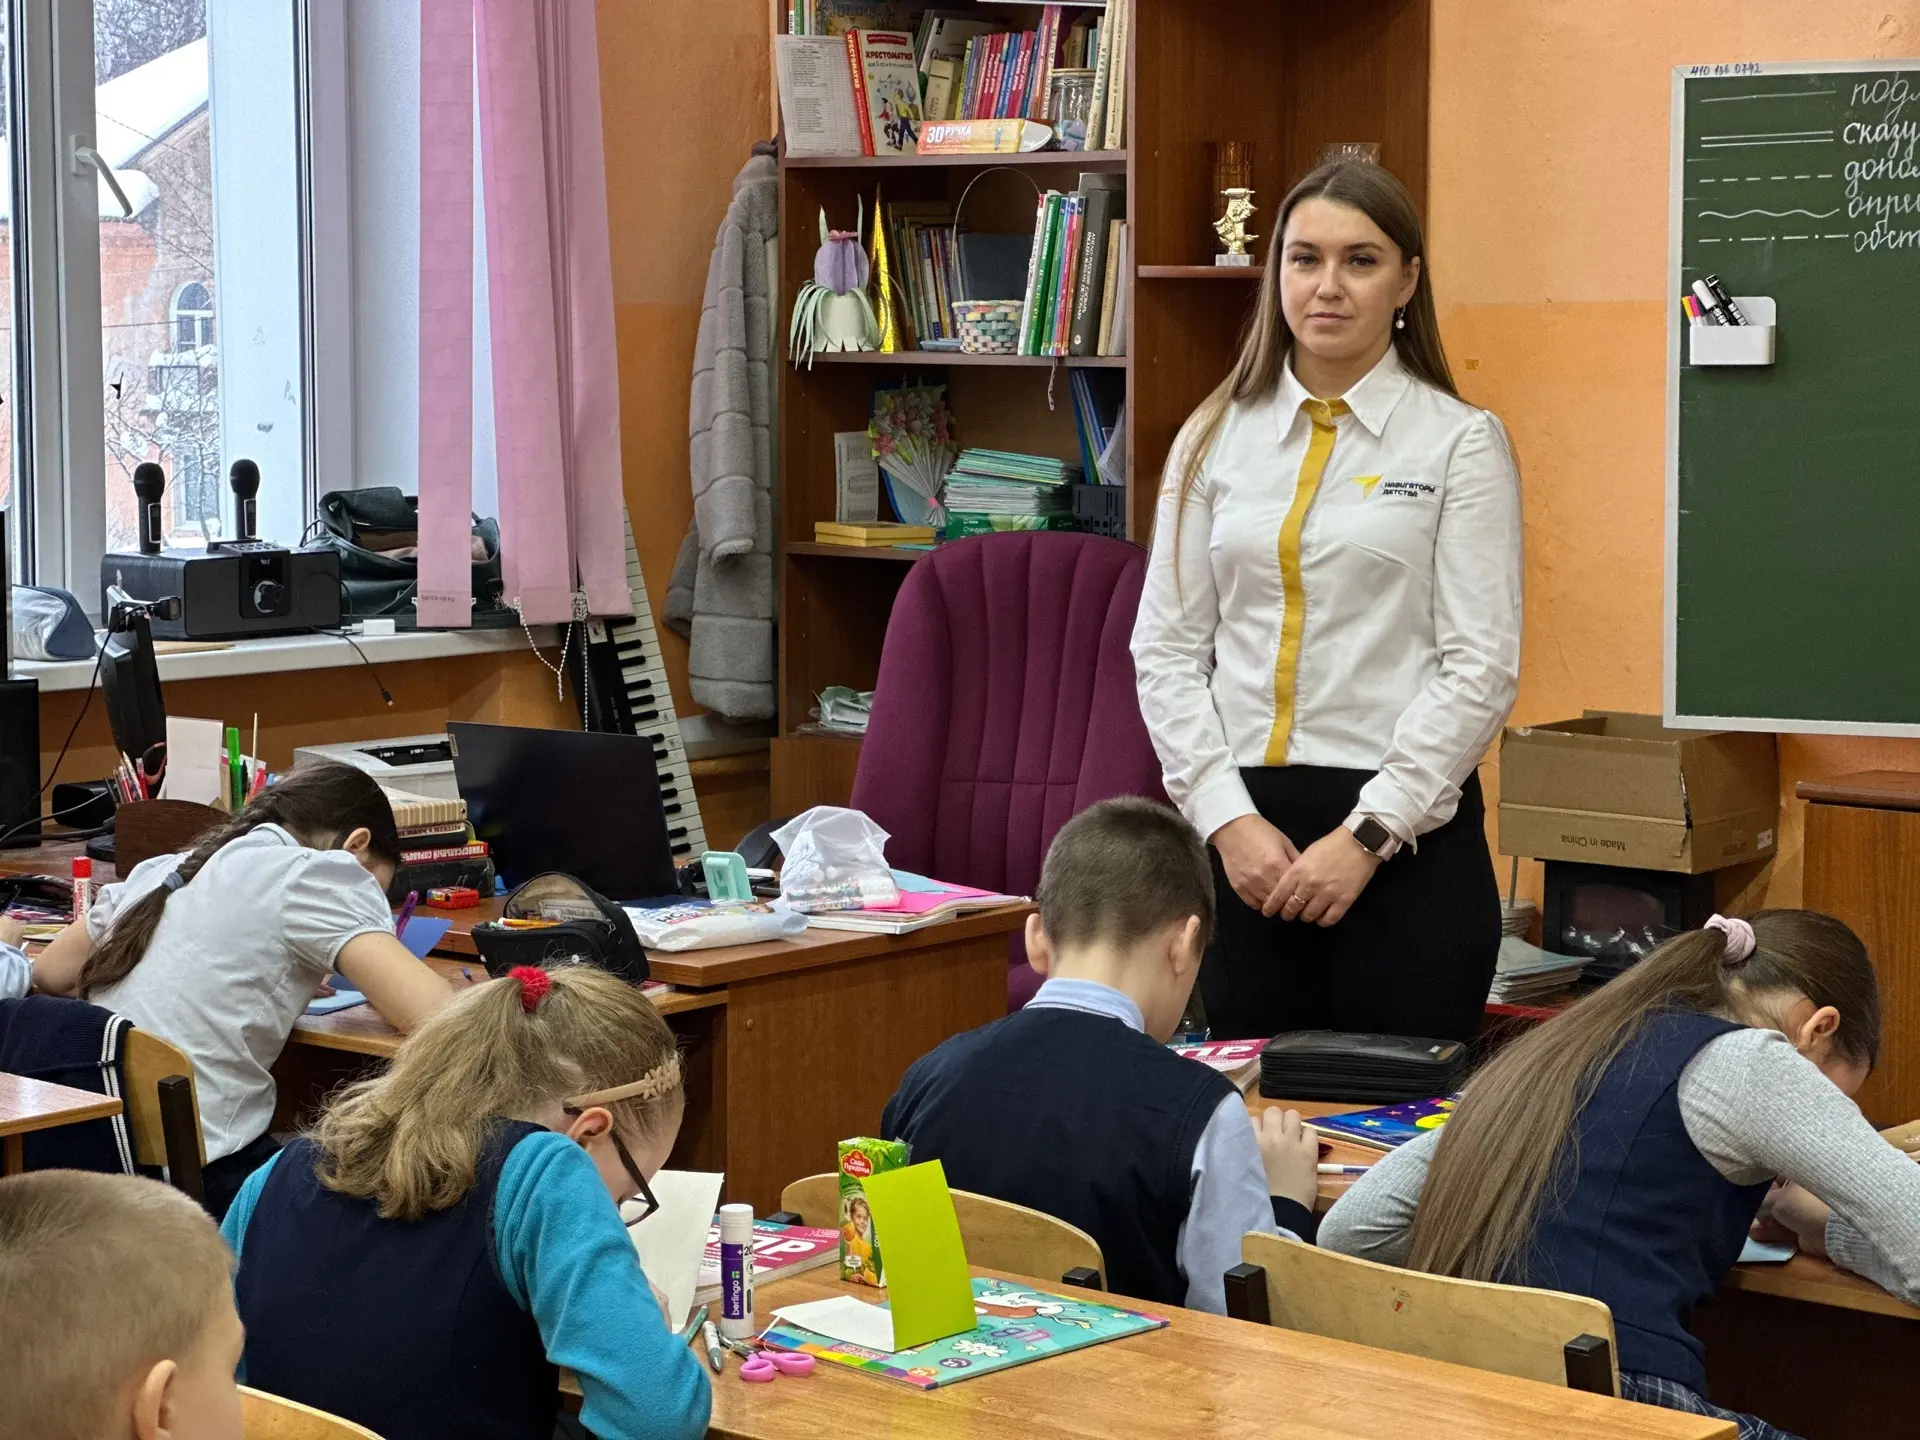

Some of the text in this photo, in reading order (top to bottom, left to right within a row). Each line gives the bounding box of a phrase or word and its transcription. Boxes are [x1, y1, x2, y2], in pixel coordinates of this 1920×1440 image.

[846, 34, 860, 89] ХРЕСТОМАТИЯ
[865, 51, 912, 60] ХРЕСТОМАТИЯ
[927, 126, 971, 143] 3D РУЧКА
[1843, 121, 1920, 159] сказу
[1849, 193, 1920, 234] опре
[1383, 489, 1418, 497] ДЕТСТВА
[1385, 482, 1435, 493] НАВИГАТОРЫ
[1561, 835, 1626, 851] Made in China
[433, 845, 484, 860] УНИВЕРСАЛЬНЫЙ
[731, 1280, 741, 1316] berlingo
